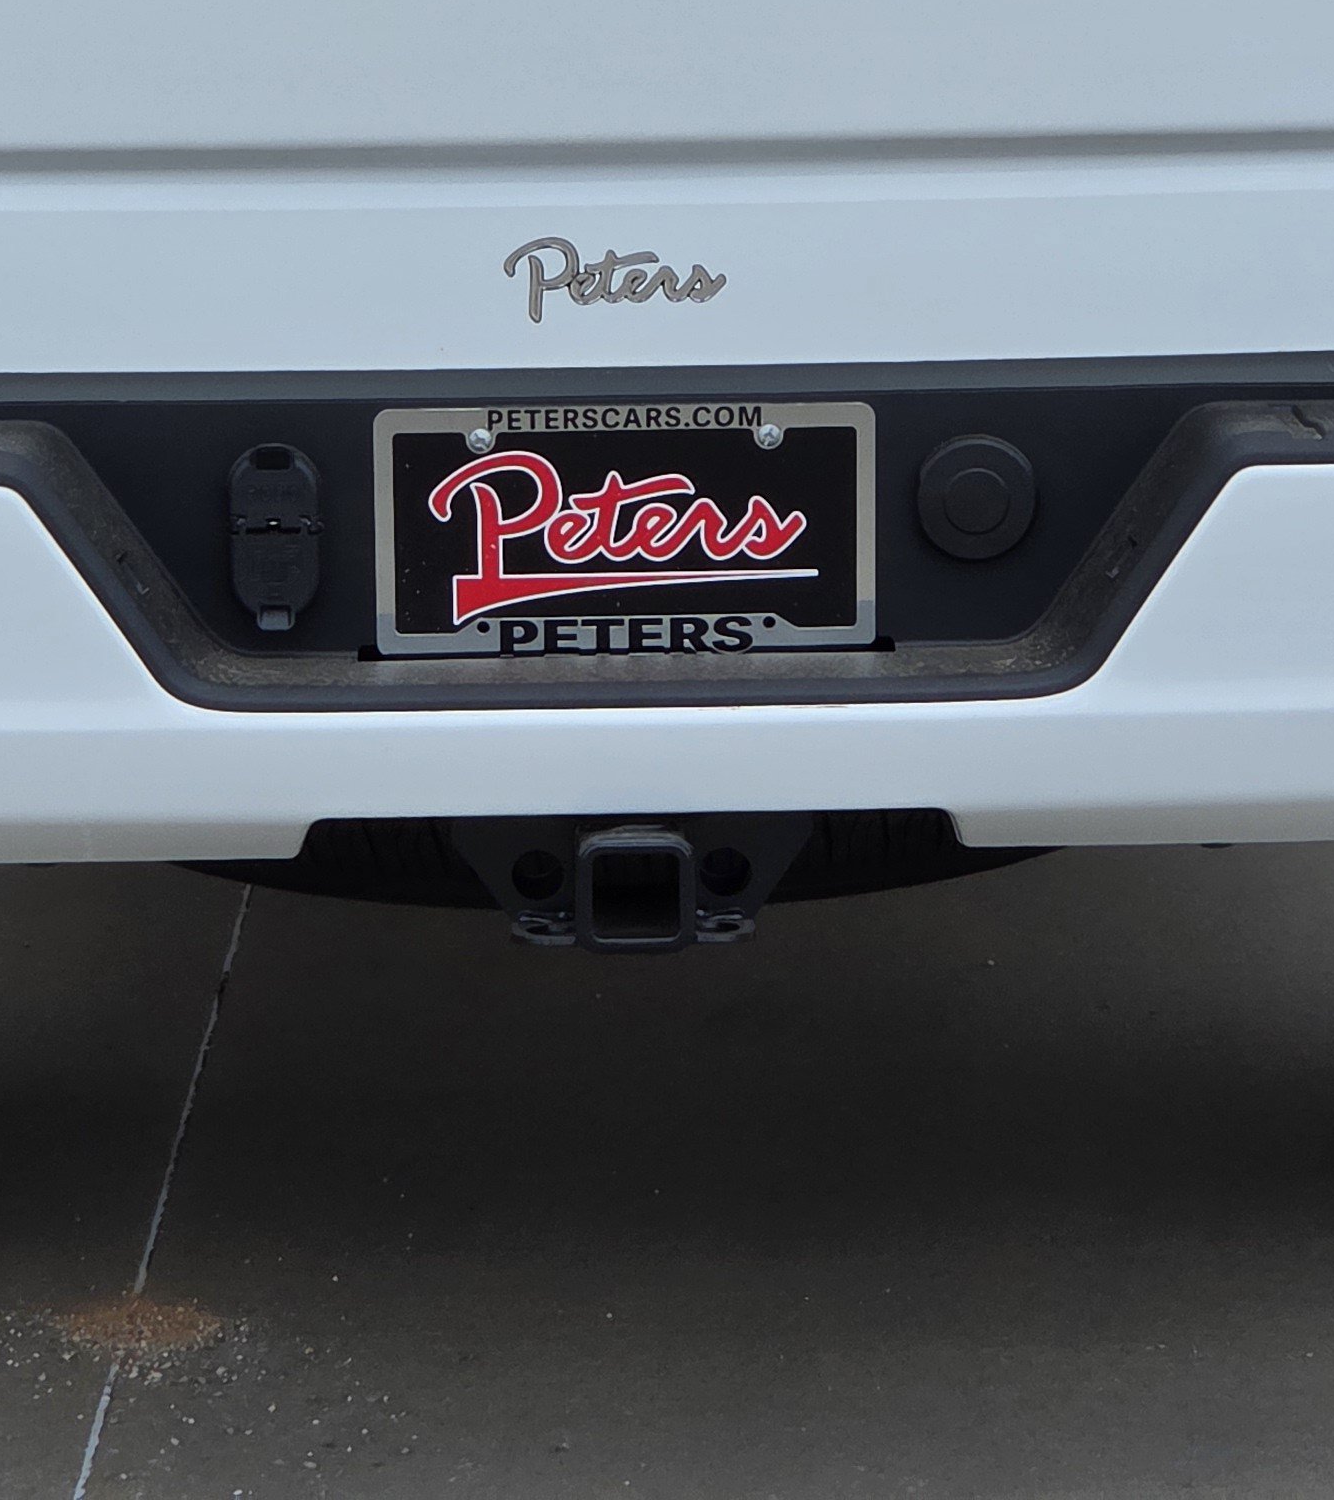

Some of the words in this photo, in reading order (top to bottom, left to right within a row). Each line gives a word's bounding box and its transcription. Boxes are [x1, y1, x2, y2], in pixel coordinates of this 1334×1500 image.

[504, 236, 727, 323] Peters
[487, 405, 762, 431] PETERSCARS.COM
[429, 451, 808, 592] Peters
[499, 615, 754, 655] PETERS
